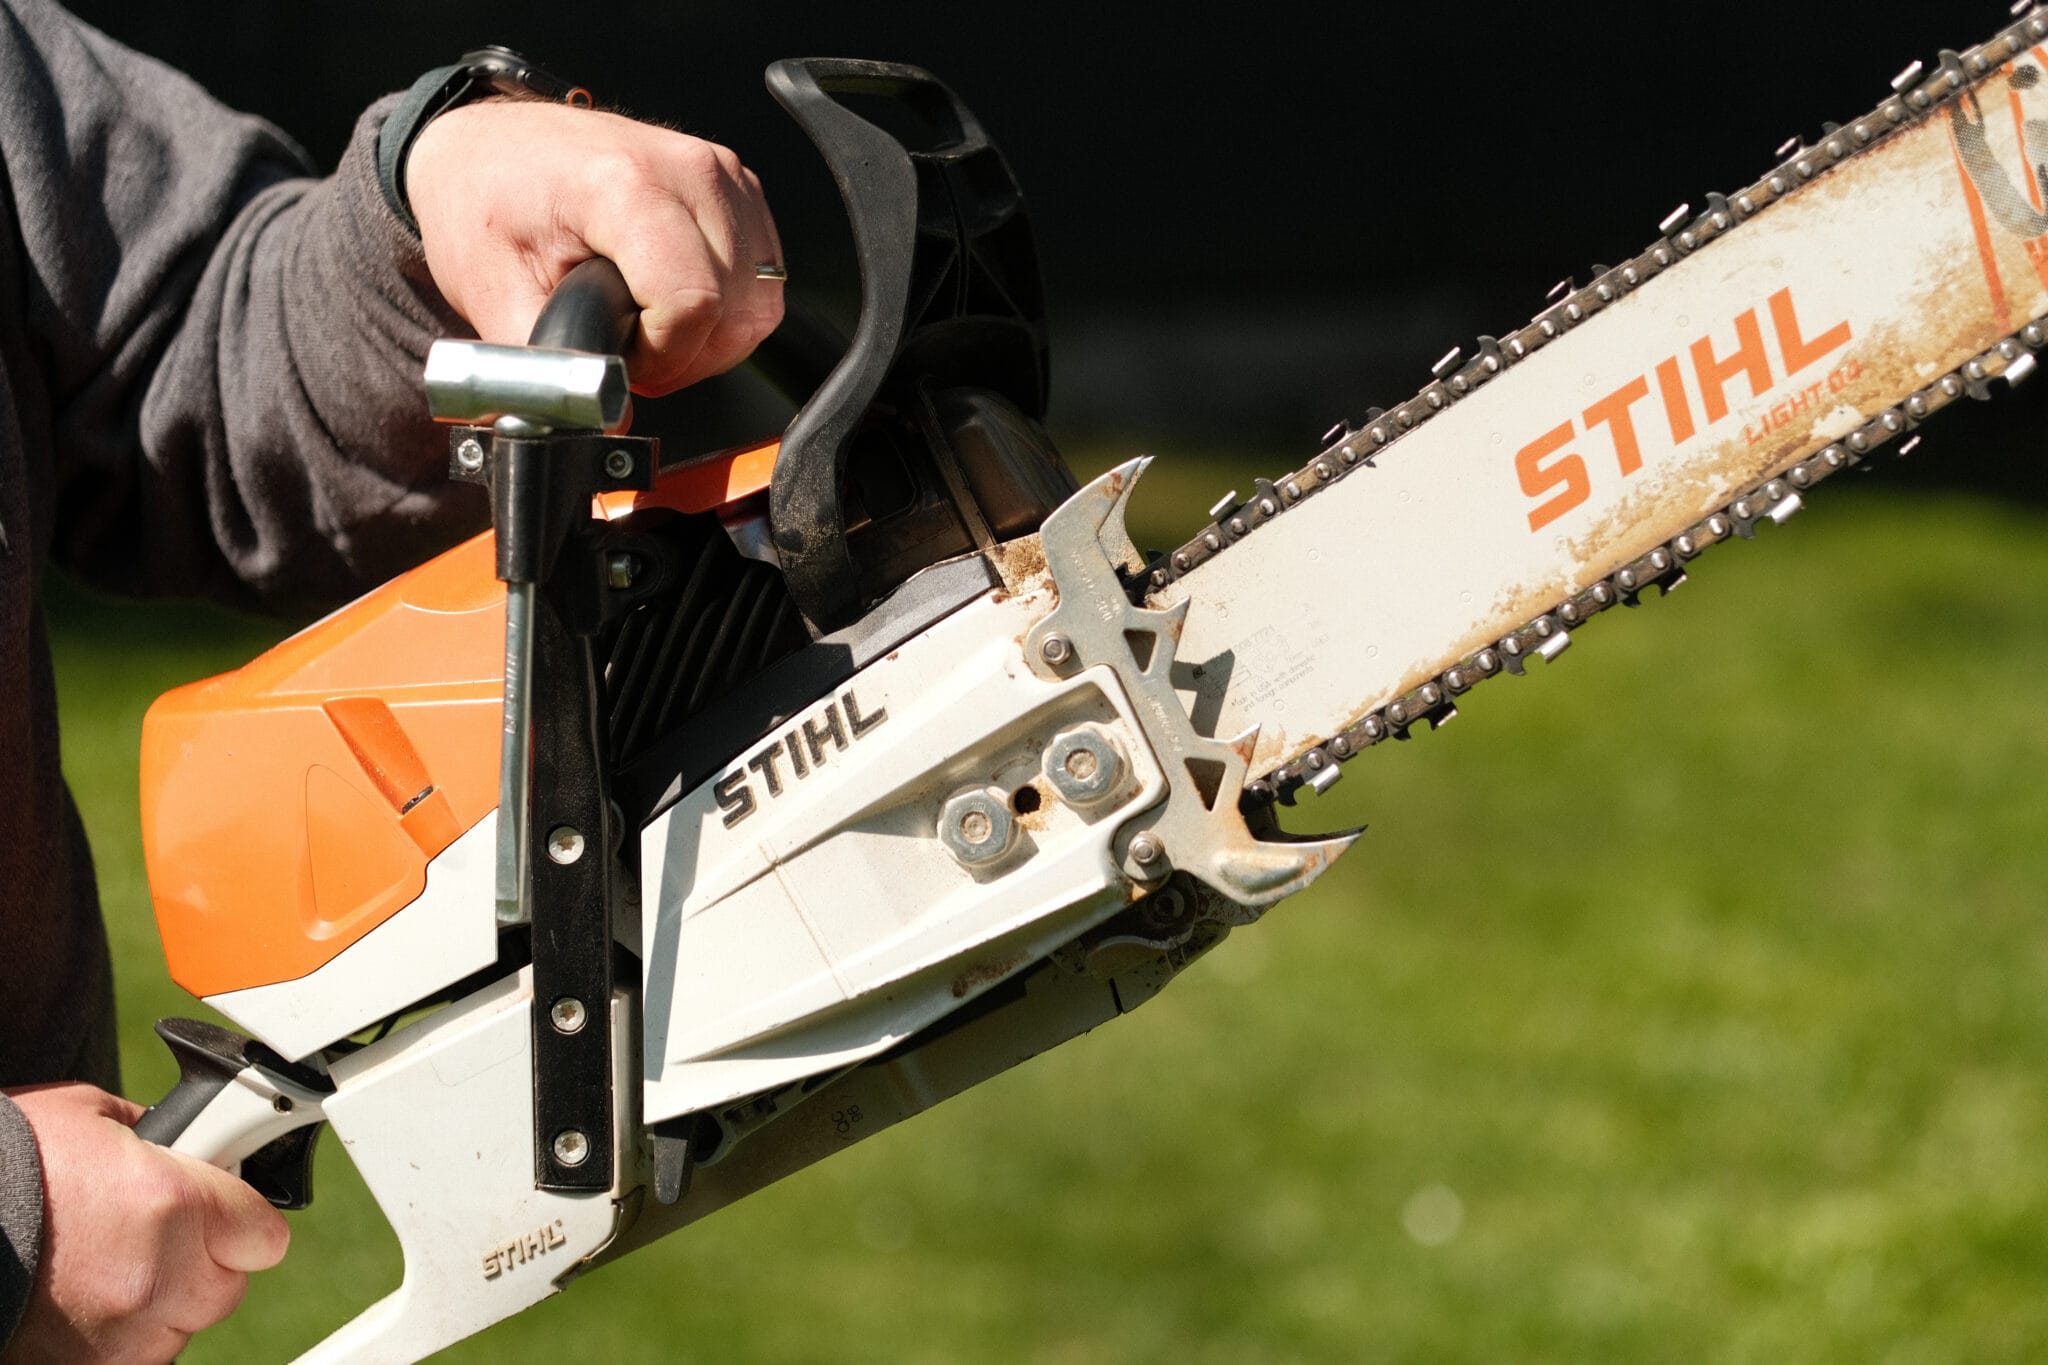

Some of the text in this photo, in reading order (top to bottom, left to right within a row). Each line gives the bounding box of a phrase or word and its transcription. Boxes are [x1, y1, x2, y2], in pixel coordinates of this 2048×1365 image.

[1515, 287, 1852, 533] STIHL
[1744, 380, 1823, 445] LIGHT
[713, 688, 888, 830] STIHL
[482, 1222, 566, 1281] STIHL
